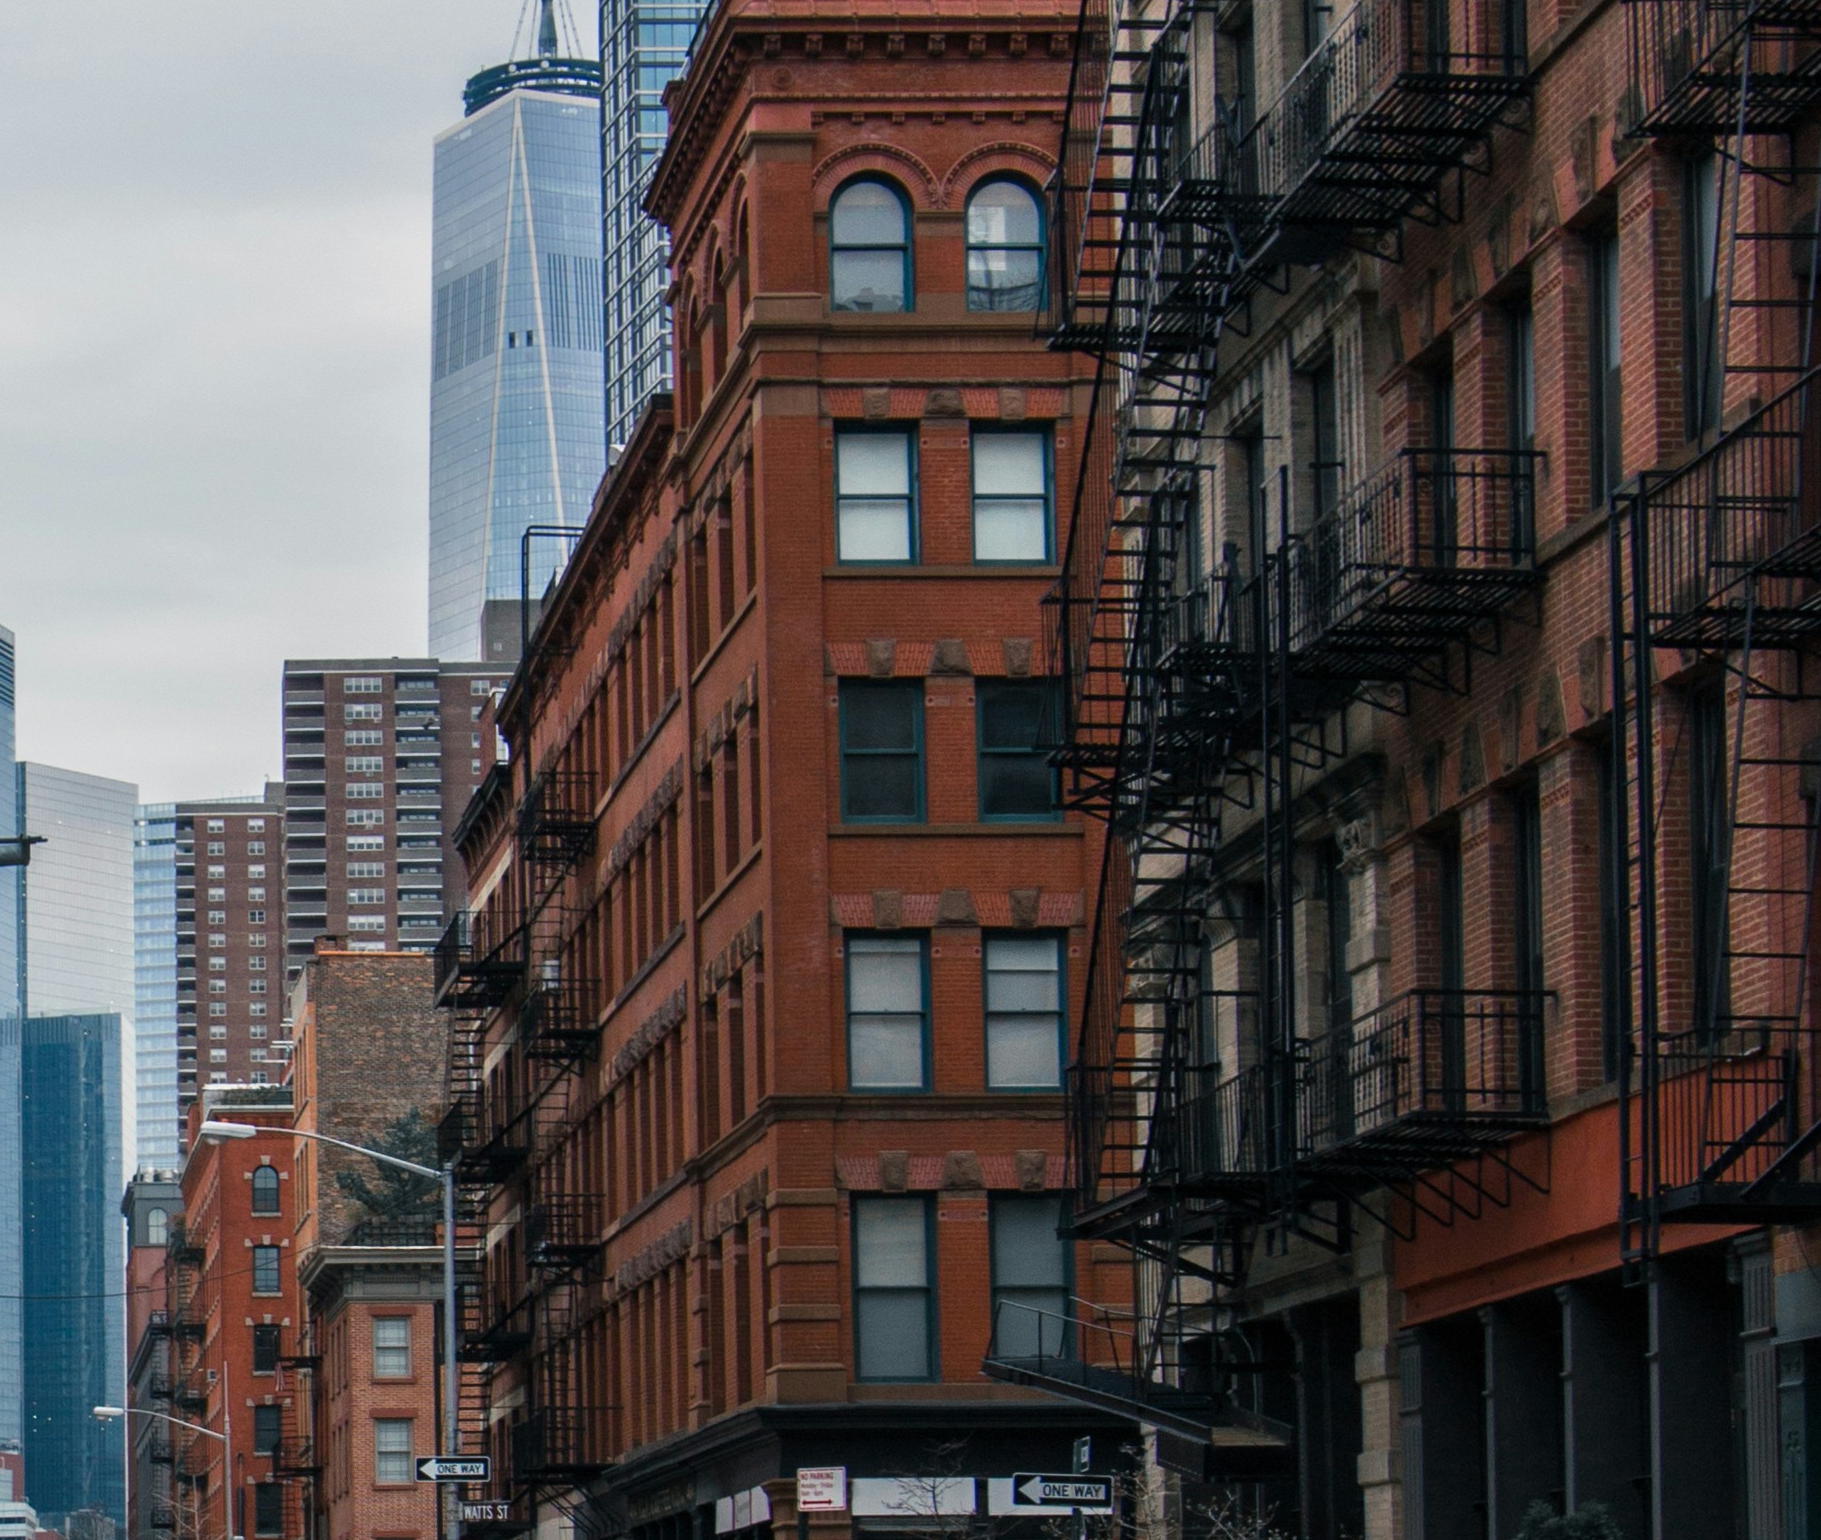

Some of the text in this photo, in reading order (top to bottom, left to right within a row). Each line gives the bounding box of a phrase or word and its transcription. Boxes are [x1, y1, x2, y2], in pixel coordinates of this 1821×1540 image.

[437, 1464, 481, 1474] ONE WAY
[1042, 1484, 1102, 1498] ONE WAY
[464, 1505, 509, 1520] WATTS ST
